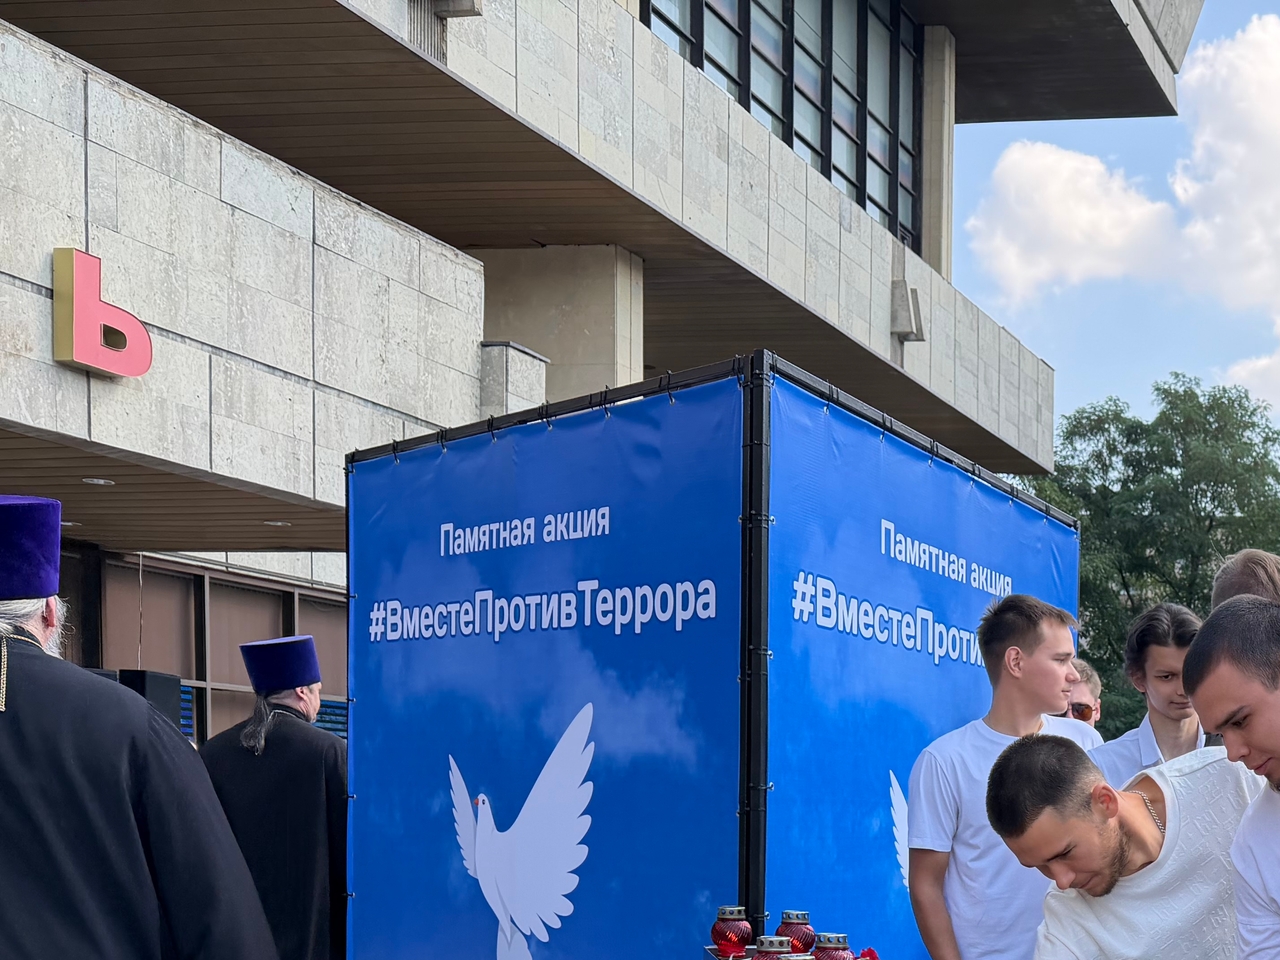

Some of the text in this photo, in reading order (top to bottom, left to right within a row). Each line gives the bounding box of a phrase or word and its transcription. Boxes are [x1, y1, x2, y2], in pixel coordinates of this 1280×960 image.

[440, 506, 610, 557] Памятная акция
[881, 518, 1012, 598] Памятная акция
[369, 579, 716, 642] #ВместеПротивТеррора
[792, 571, 986, 668] #ВместеПроти
